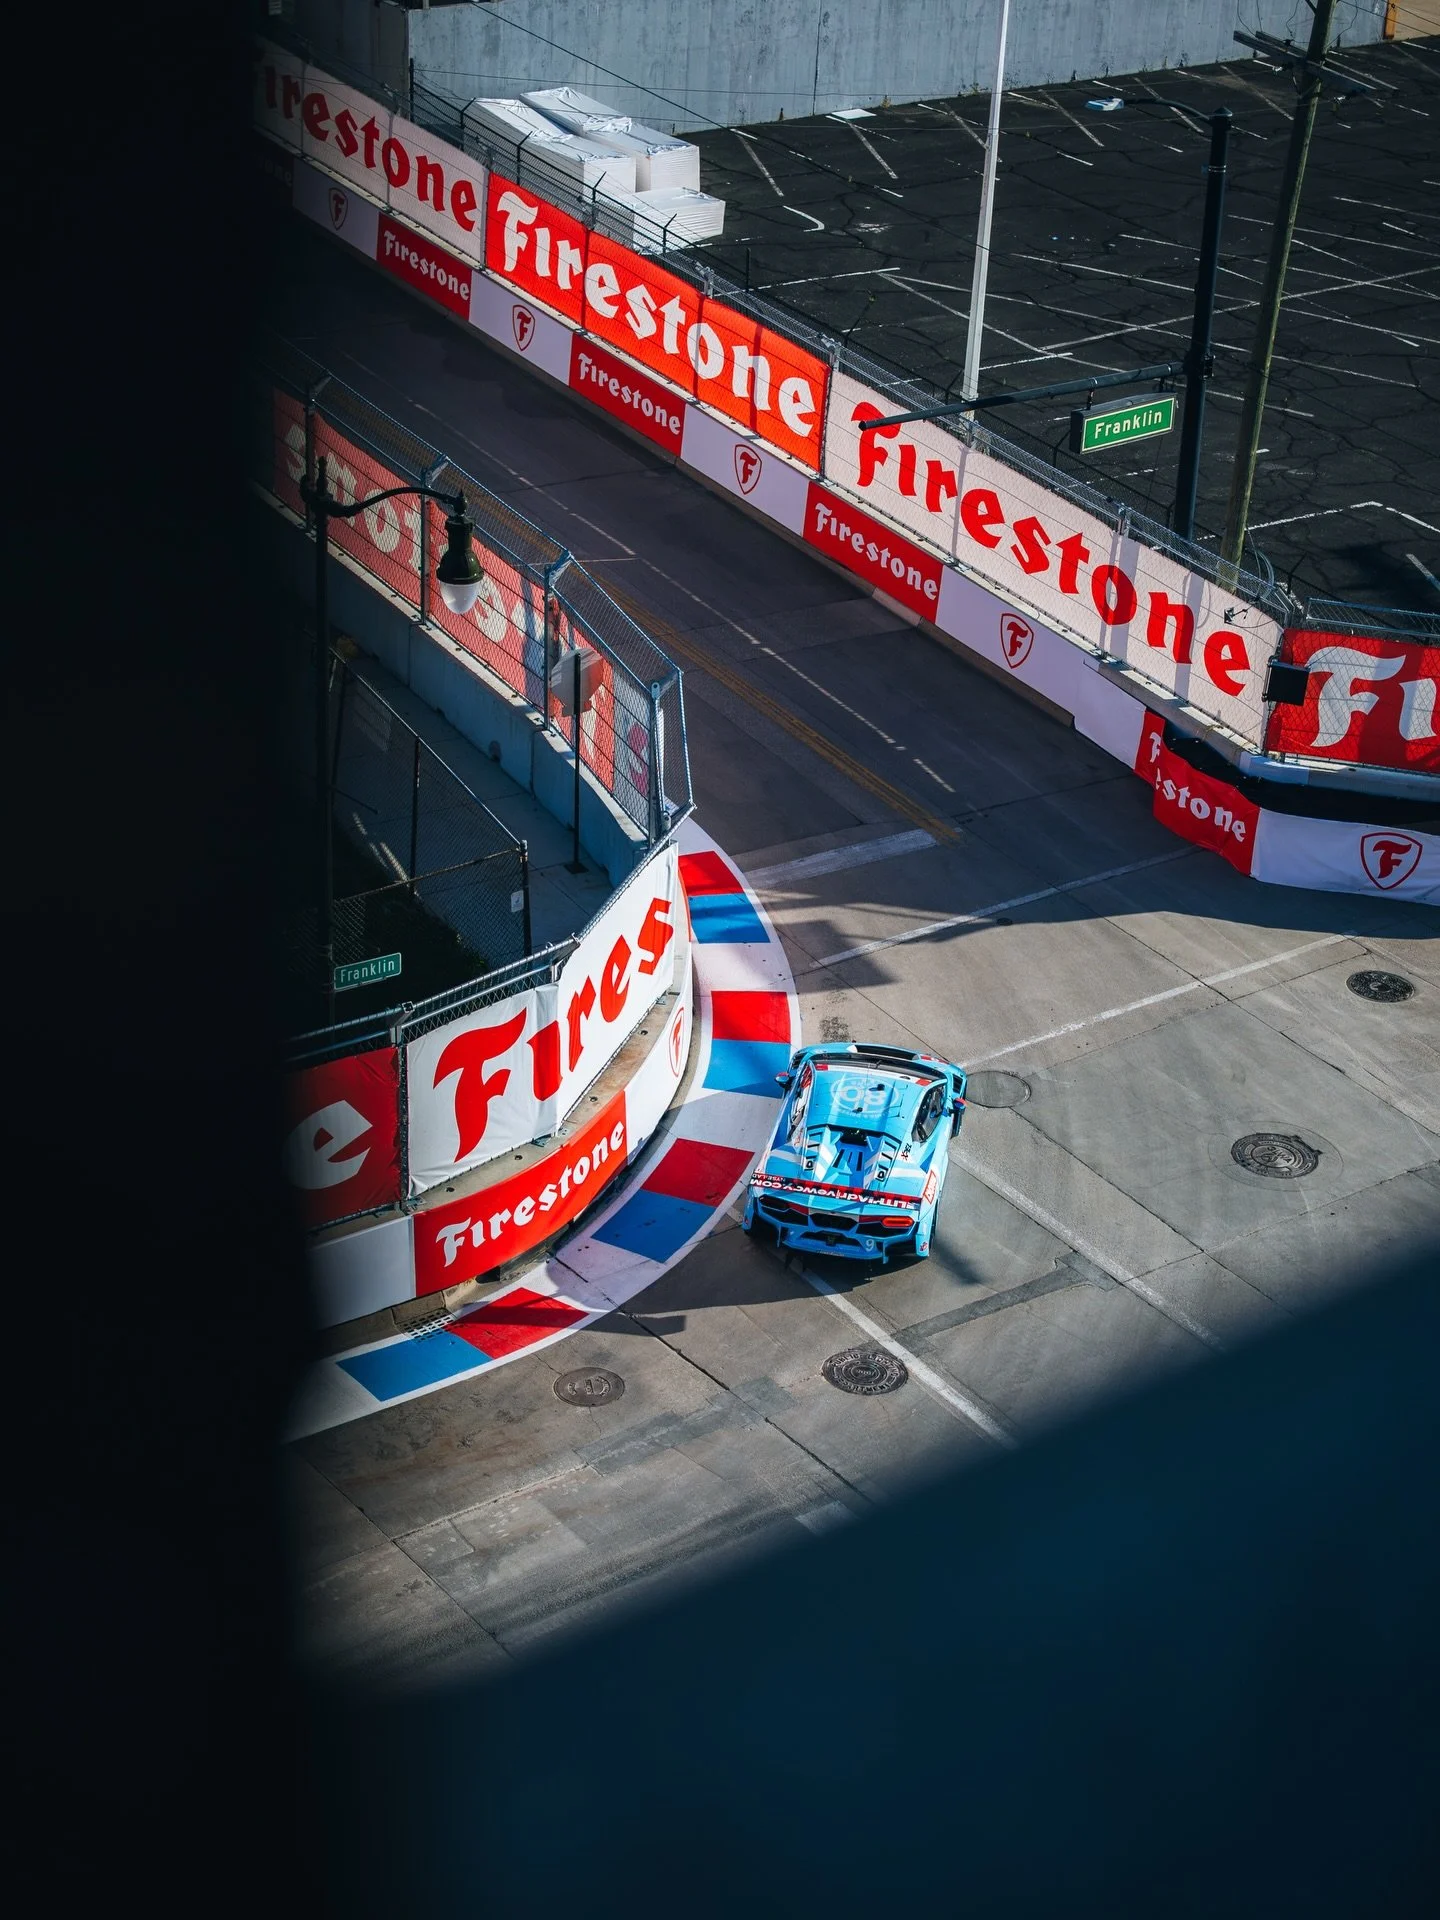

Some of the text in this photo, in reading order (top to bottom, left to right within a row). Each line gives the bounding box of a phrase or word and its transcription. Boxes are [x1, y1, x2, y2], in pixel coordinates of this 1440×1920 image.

[264, 65, 478, 233] irestone
[382, 229, 470, 302] Firestone
[497, 190, 816, 437] Firestone
[577, 352, 681, 435] Firestone
[1094, 410, 1162, 439] Franklin
[814, 502, 938, 601] Firestone
[851, 401, 1250, 697] Firestone
[340, 959, 395, 983] Franklin
[435, 1116, 625, 1268] Firestone
[865, 1238, 875, 1252] 9
